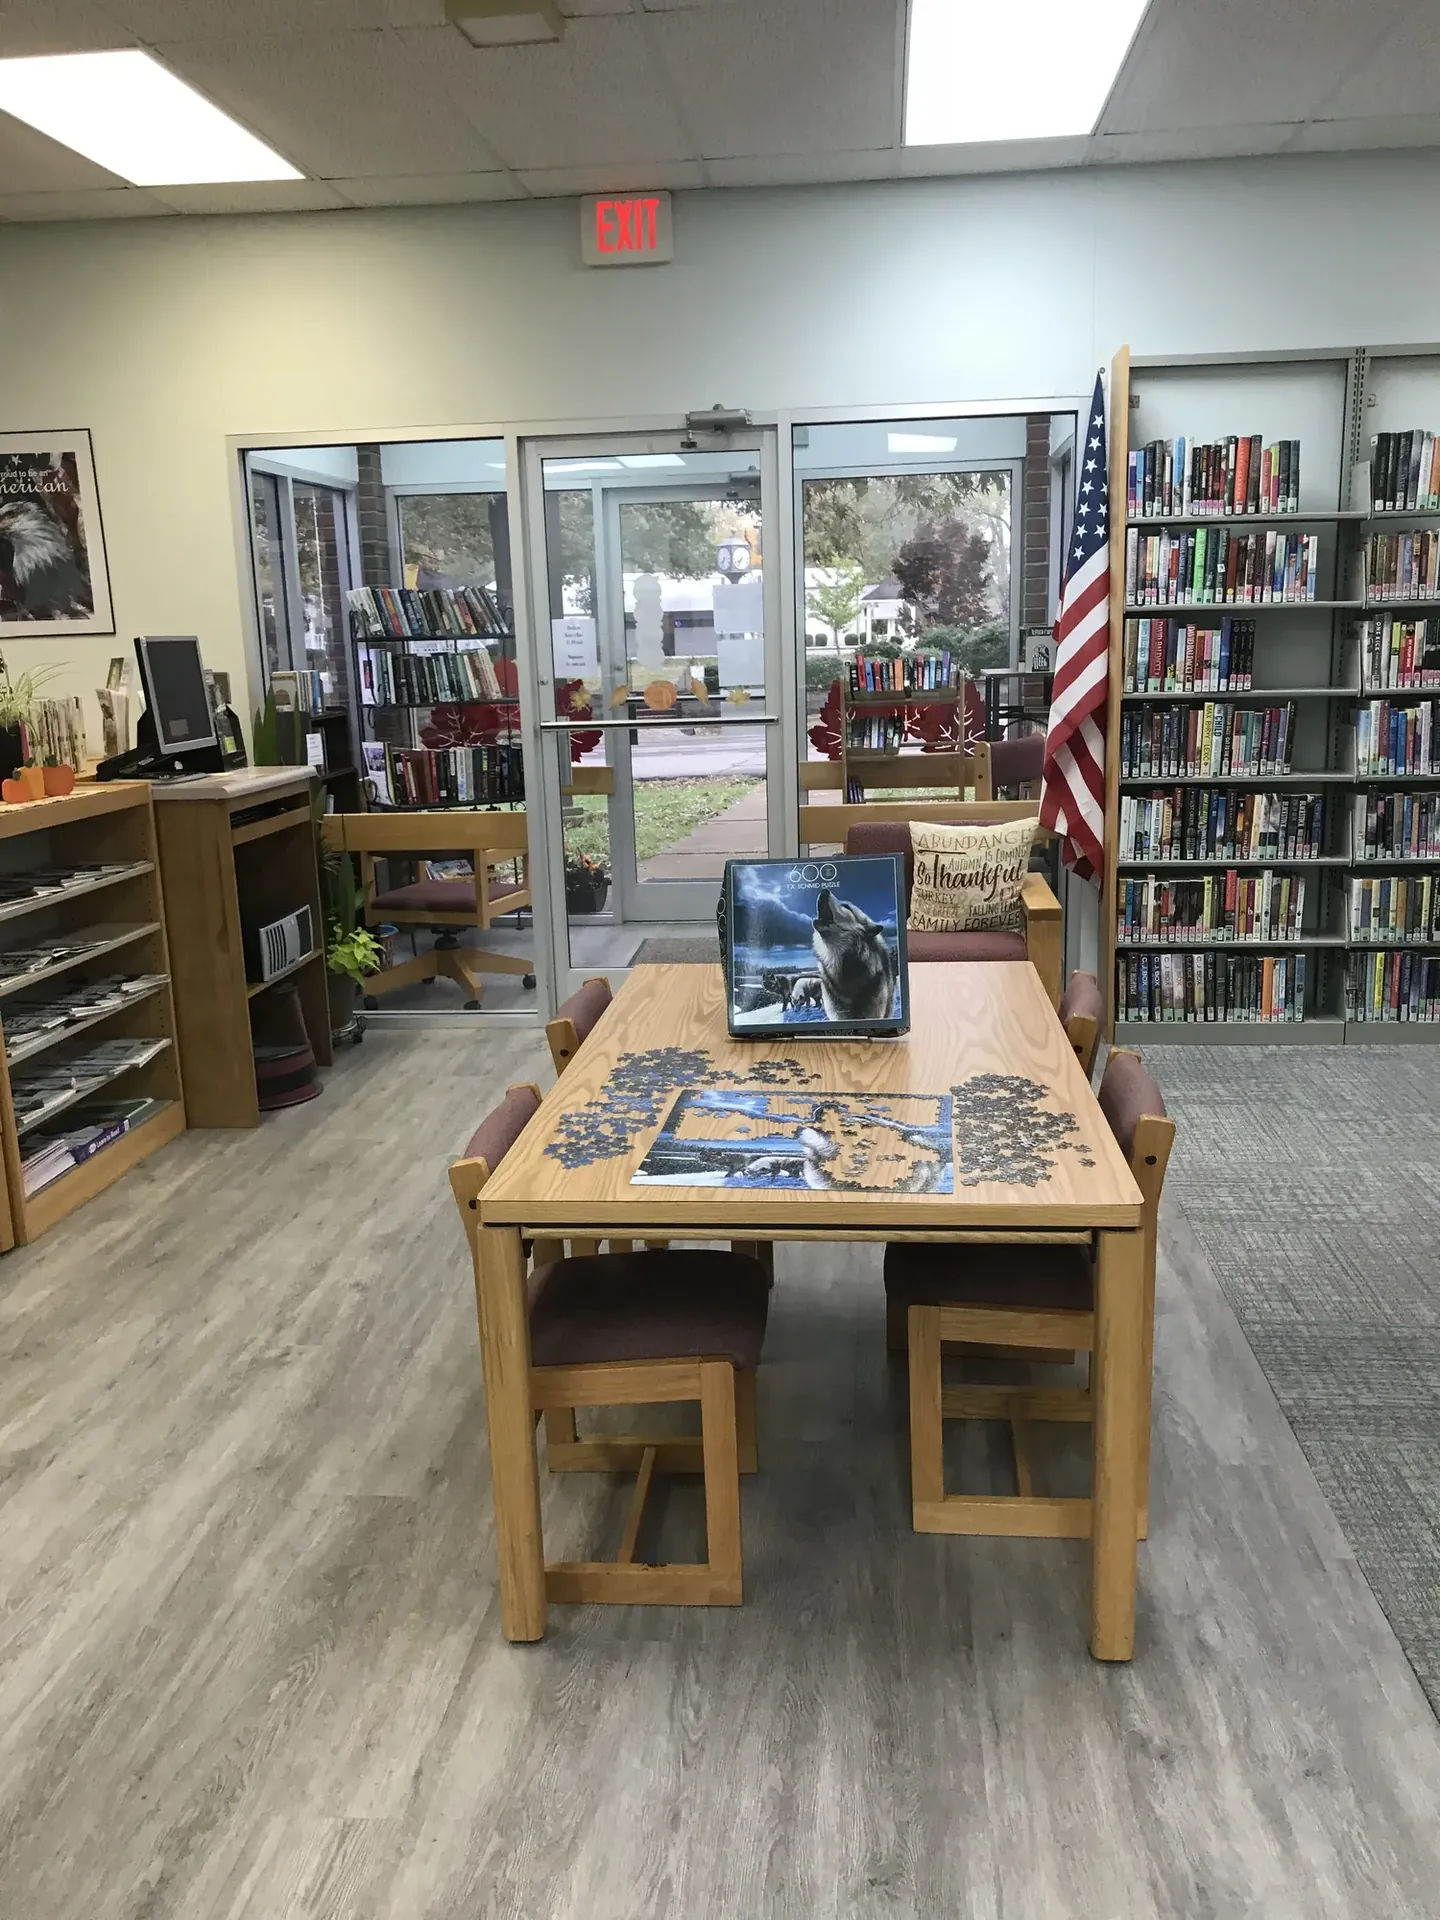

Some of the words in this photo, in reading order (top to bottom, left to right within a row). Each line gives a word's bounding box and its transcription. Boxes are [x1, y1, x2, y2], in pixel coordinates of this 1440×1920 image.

[596, 198, 660, 253] EXIT
[1156, 620, 1164, 640] DAVID
[1186, 626, 1195, 645] DAVID
[1154, 641, 1163, 671] BALDACCI
[1185, 645, 1195, 674] BALDACCI
[1214, 716, 1223, 737] CHILD
[918, 827, 1031, 851] ABUNDANCE
[985, 850, 993, 863] IS
[790, 863, 838, 883] 600
[917, 860, 931, 886] So
[914, 888, 956, 905] TURKEY
[968, 901, 1000, 917] FALLING
[912, 910, 960, 932] FAMILY
[964, 910, 1021, 931] FOREVER
